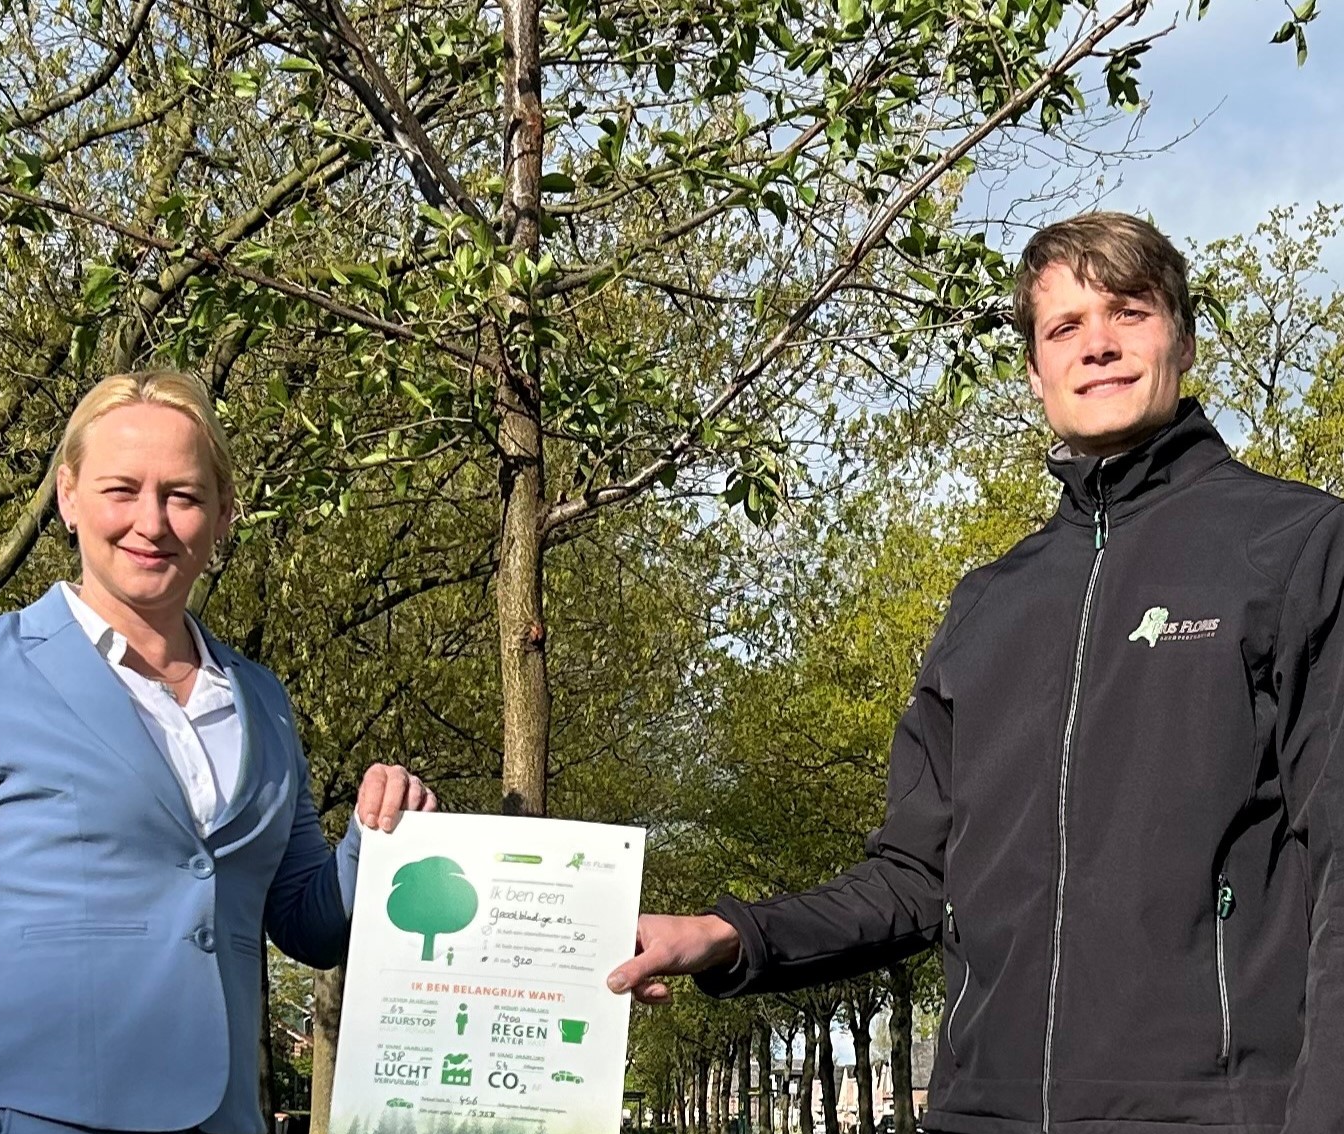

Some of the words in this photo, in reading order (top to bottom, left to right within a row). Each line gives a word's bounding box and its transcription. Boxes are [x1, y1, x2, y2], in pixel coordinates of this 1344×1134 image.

[489, 886, 502, 900] Ik
[506, 886, 534, 902] ben
[538, 891, 565, 905] een
[573, 932, 585, 941] 50
[559, 945, 576, 953] 20
[411, 982, 423, 991] IK
[427, 983, 449, 992] BEN
[453, 985, 525, 998] BELANGRIJK
[529, 990, 565, 1003] WANT:
[380, 1015, 436, 1027] ZUURSTOF
[491, 1023, 548, 1039] REGEN
[491, 1036, 524, 1045] WATER
[375, 1062, 432, 1079] LUCHT
